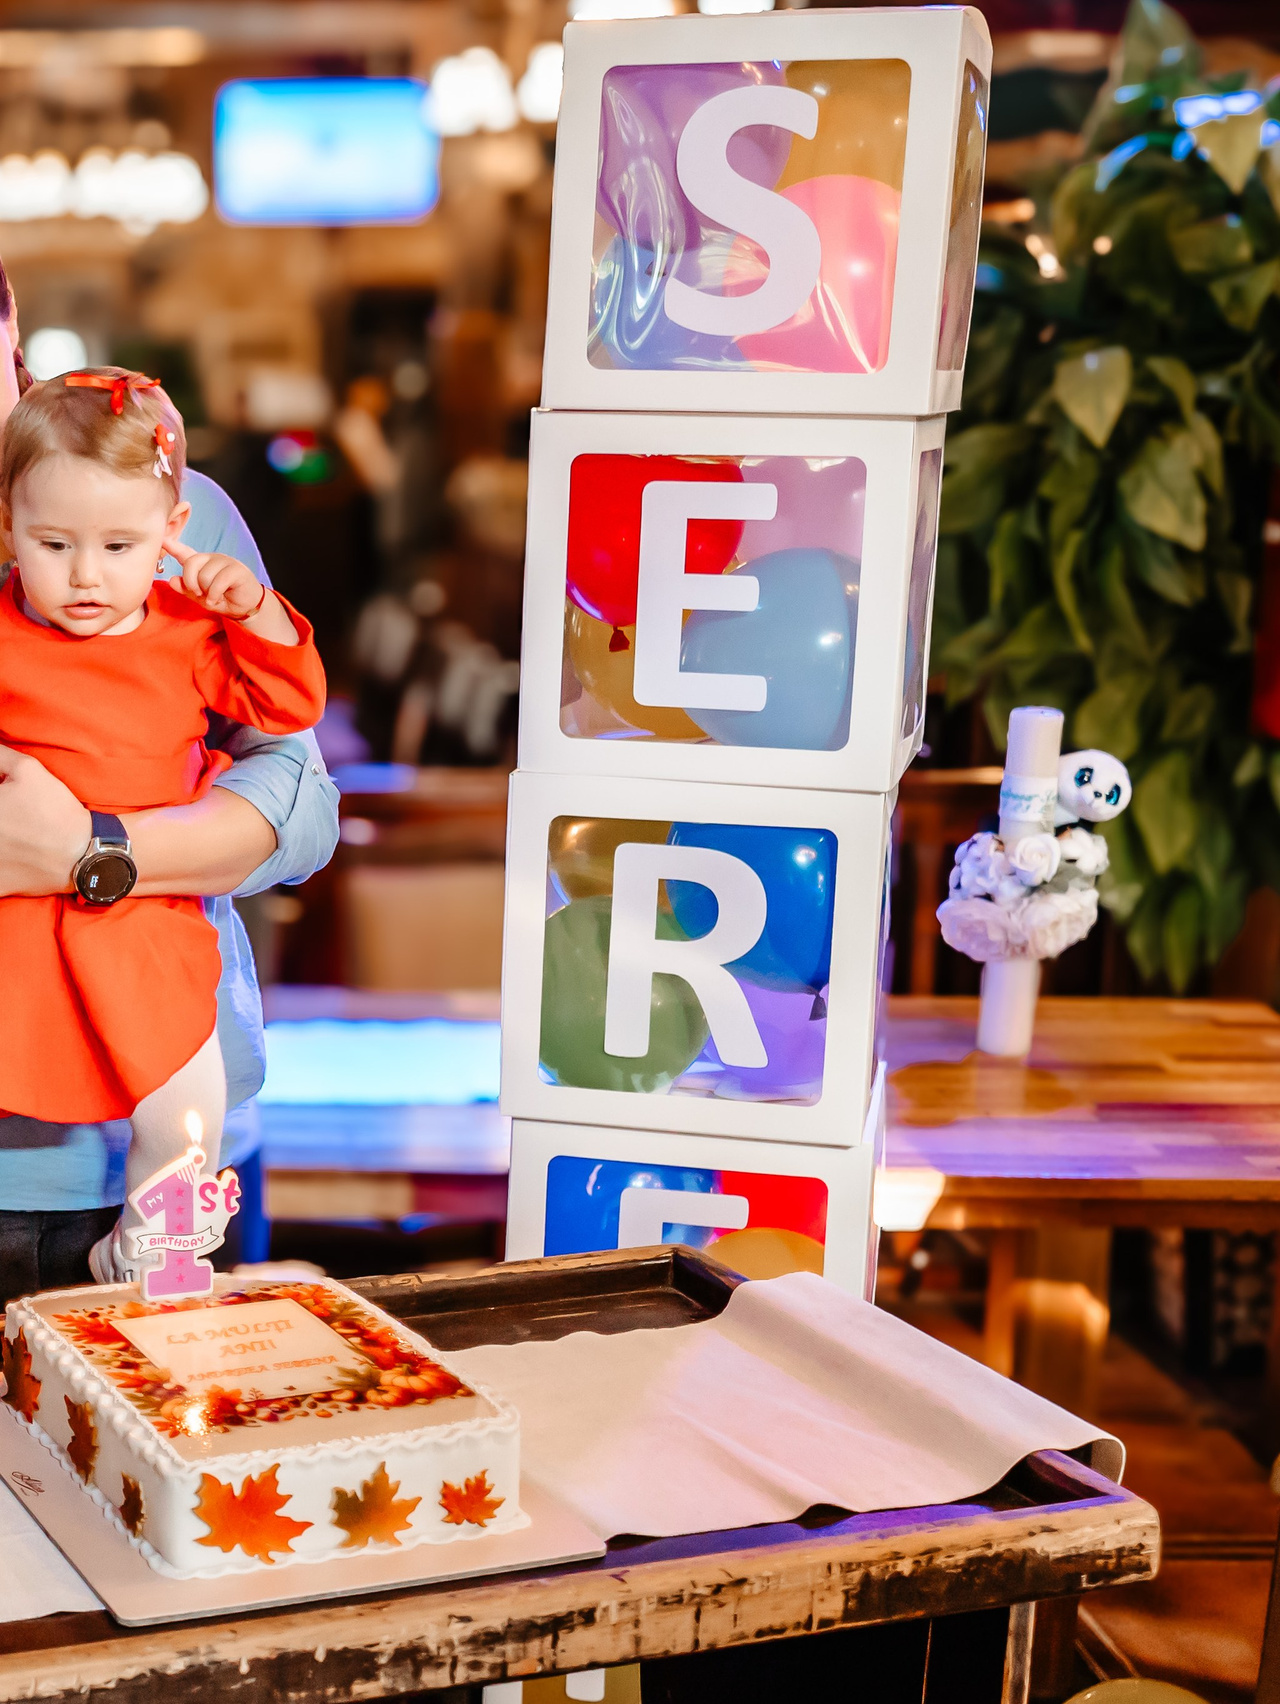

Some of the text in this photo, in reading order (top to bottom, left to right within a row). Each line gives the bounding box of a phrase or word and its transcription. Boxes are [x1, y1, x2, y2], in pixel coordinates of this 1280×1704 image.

[664, 85, 821, 336] S
[633, 480, 778, 712] E
[604, 841, 768, 1069] R
[146, 1192, 164, 1209] MY
[149, 1235, 206, 1248] BIRTHDAY
[166, 1331, 202, 1345] LA
